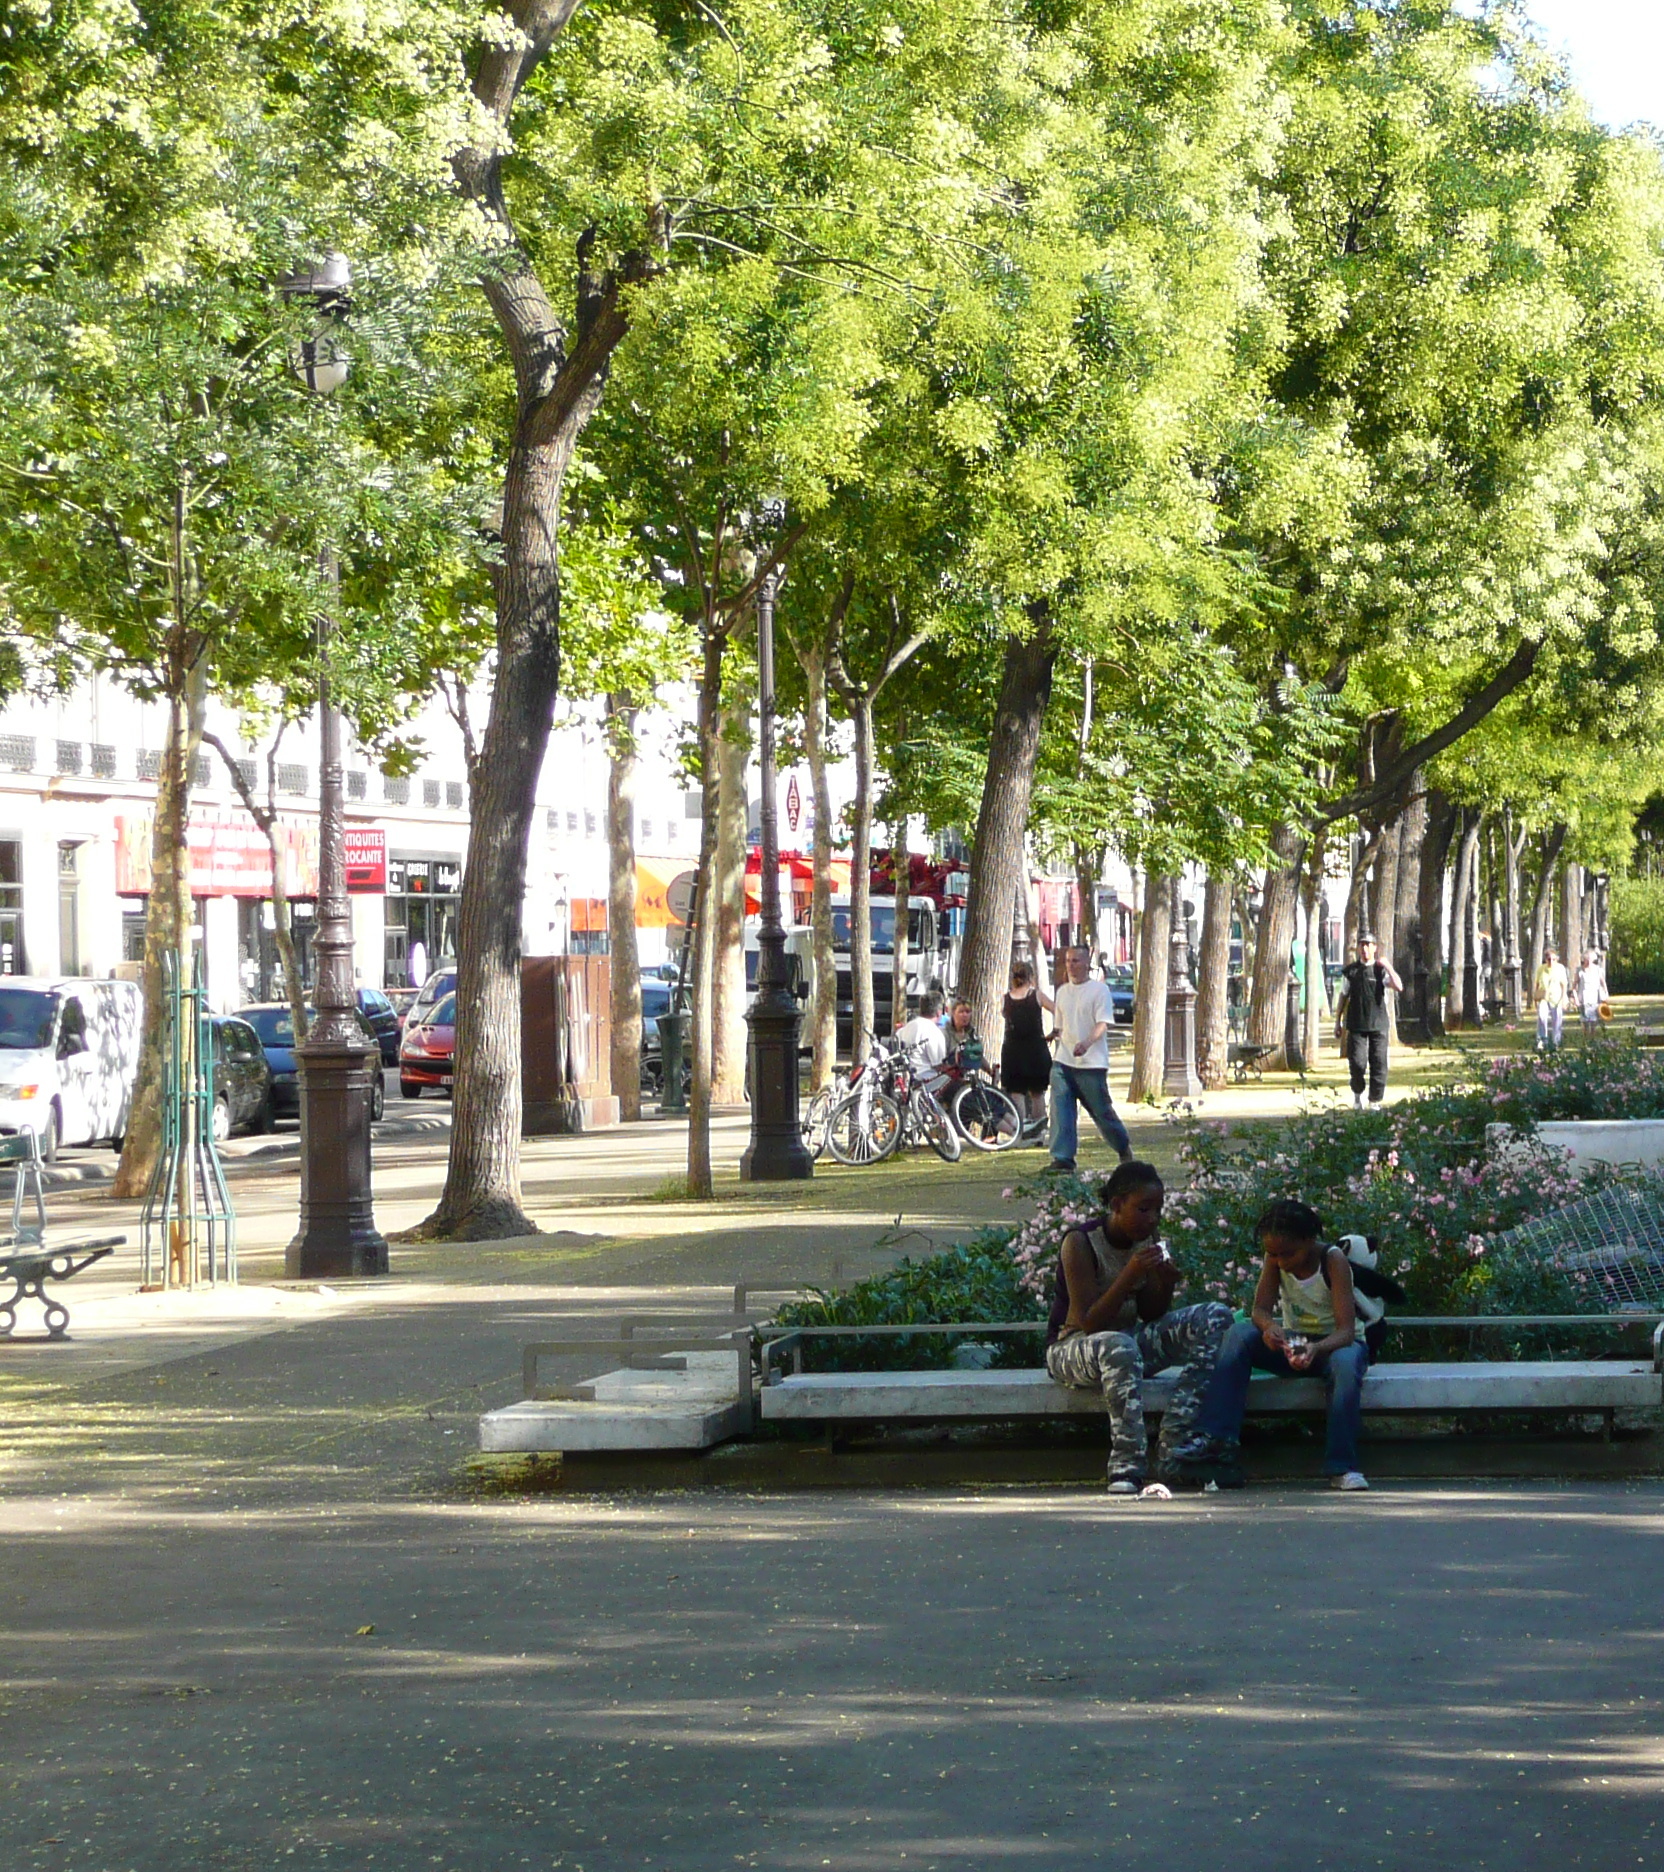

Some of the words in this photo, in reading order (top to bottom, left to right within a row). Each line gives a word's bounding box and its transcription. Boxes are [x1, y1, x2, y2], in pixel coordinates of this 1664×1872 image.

[789, 777, 799, 829] TABAC
[345, 832, 384, 847] TIQUITES
[345, 850, 383, 864] ROCANTE
